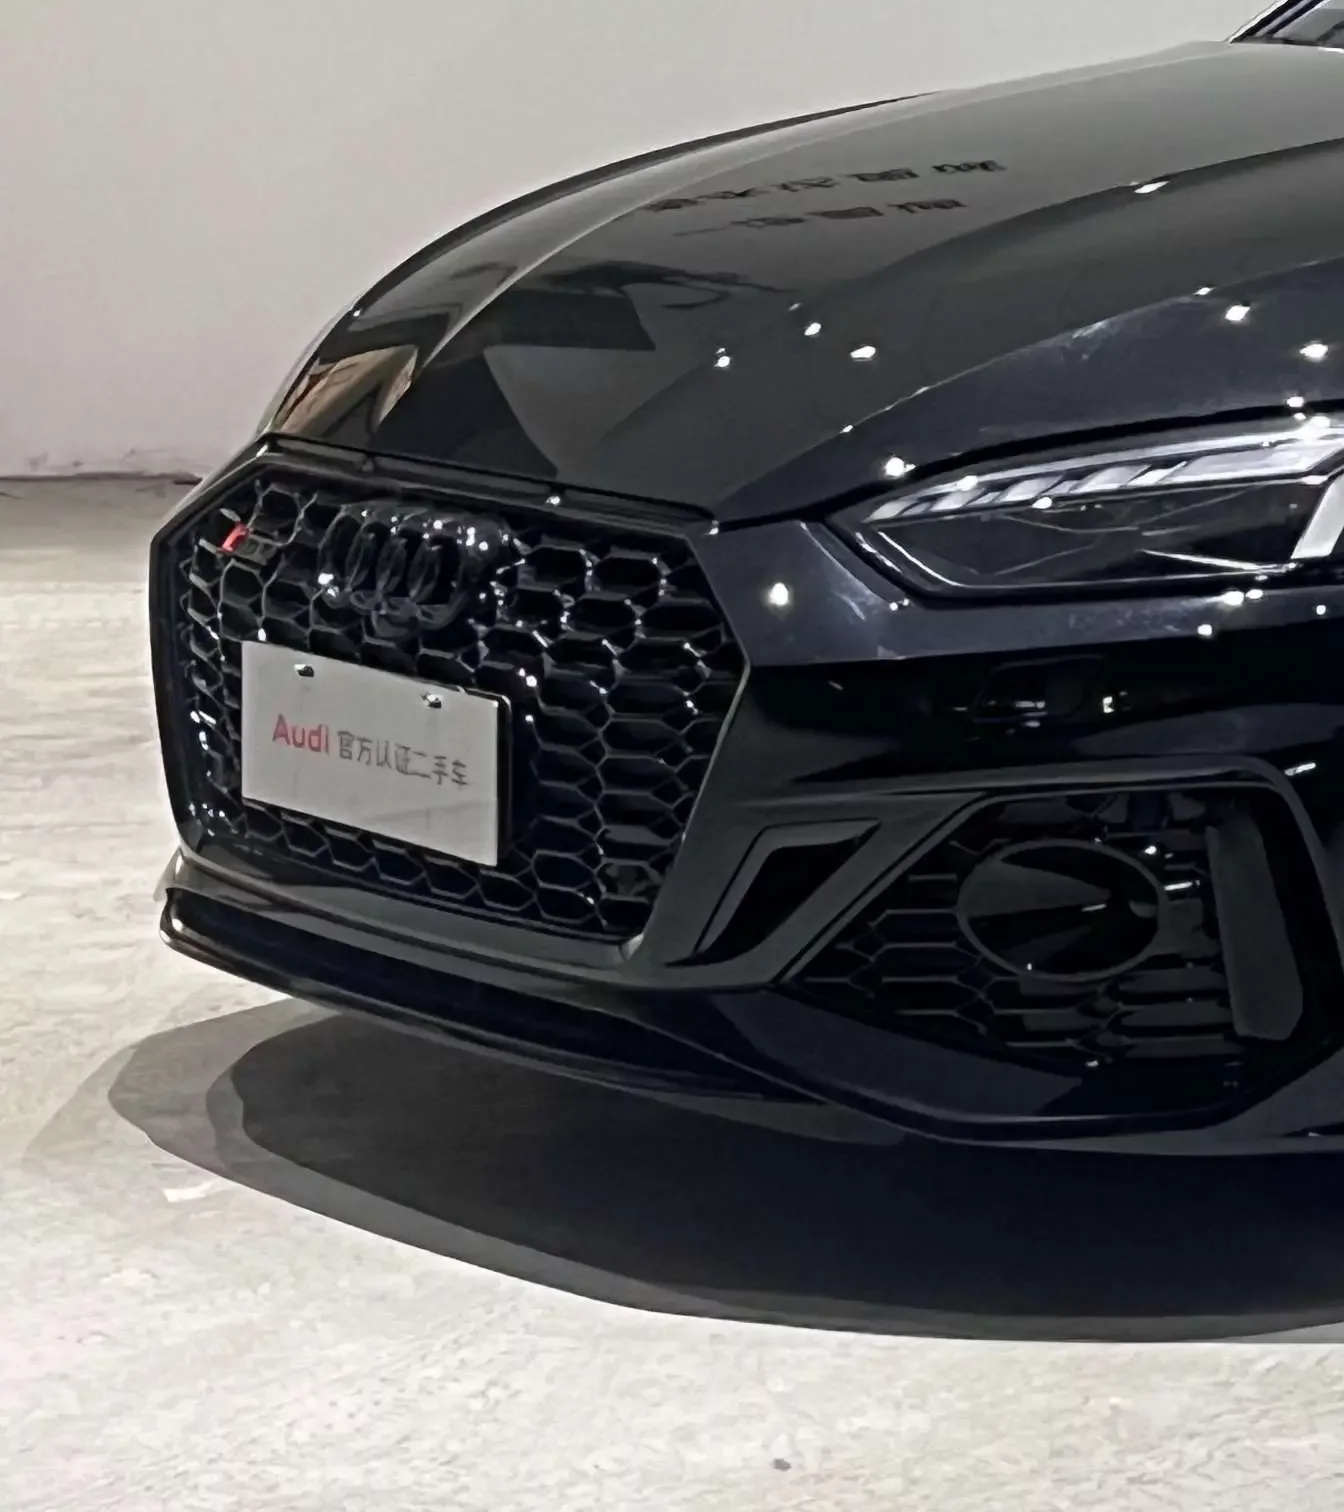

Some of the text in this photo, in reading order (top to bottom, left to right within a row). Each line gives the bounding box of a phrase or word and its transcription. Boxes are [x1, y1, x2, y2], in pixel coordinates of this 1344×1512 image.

[272, 713, 469, 788] Audi 官方认证二手车
